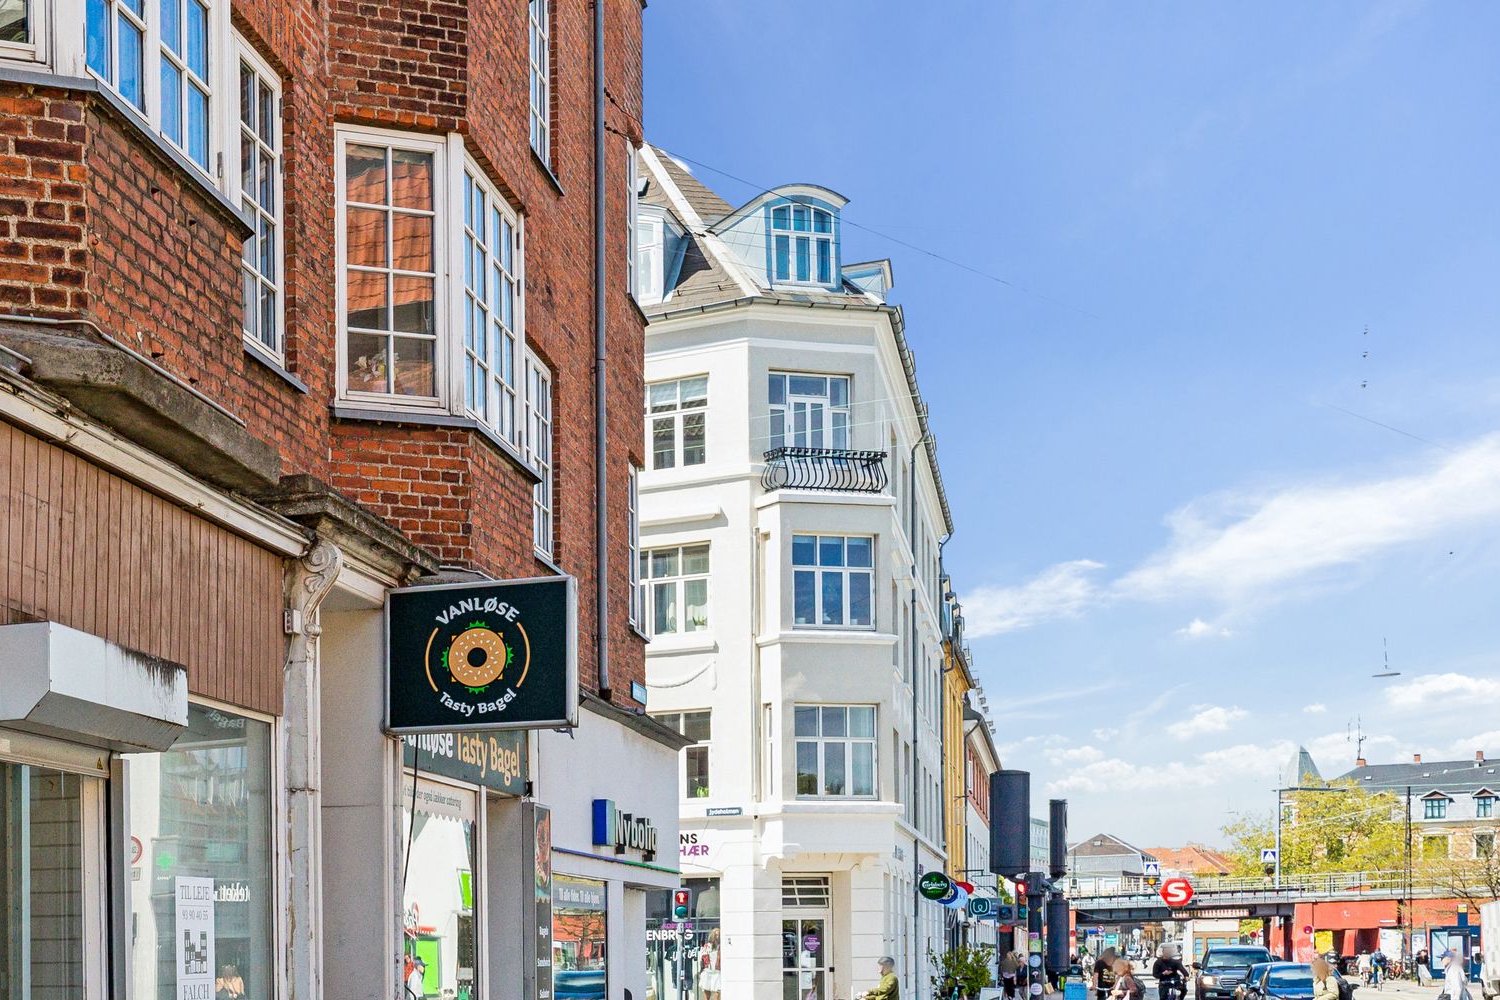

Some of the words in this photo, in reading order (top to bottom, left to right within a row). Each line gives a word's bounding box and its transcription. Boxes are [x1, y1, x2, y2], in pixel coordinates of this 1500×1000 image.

[435, 597, 520, 626] VANLØSE
[439, 691, 475, 717] Tasty
[477, 687, 517, 715] Bagel
[403, 733, 453, 758] anløse
[457, 733, 488, 779] Tasty
[489, 737, 521, 786] Bagel
[615, 809, 658, 858] Nybolig
[180, 885, 191, 900] TIL
[193, 886, 210, 901] LEJE
[922, 881, 947, 889] Carlsberg
[1167, 883, 1187, 901] S
[183, 984, 209, 1000] FALCH
